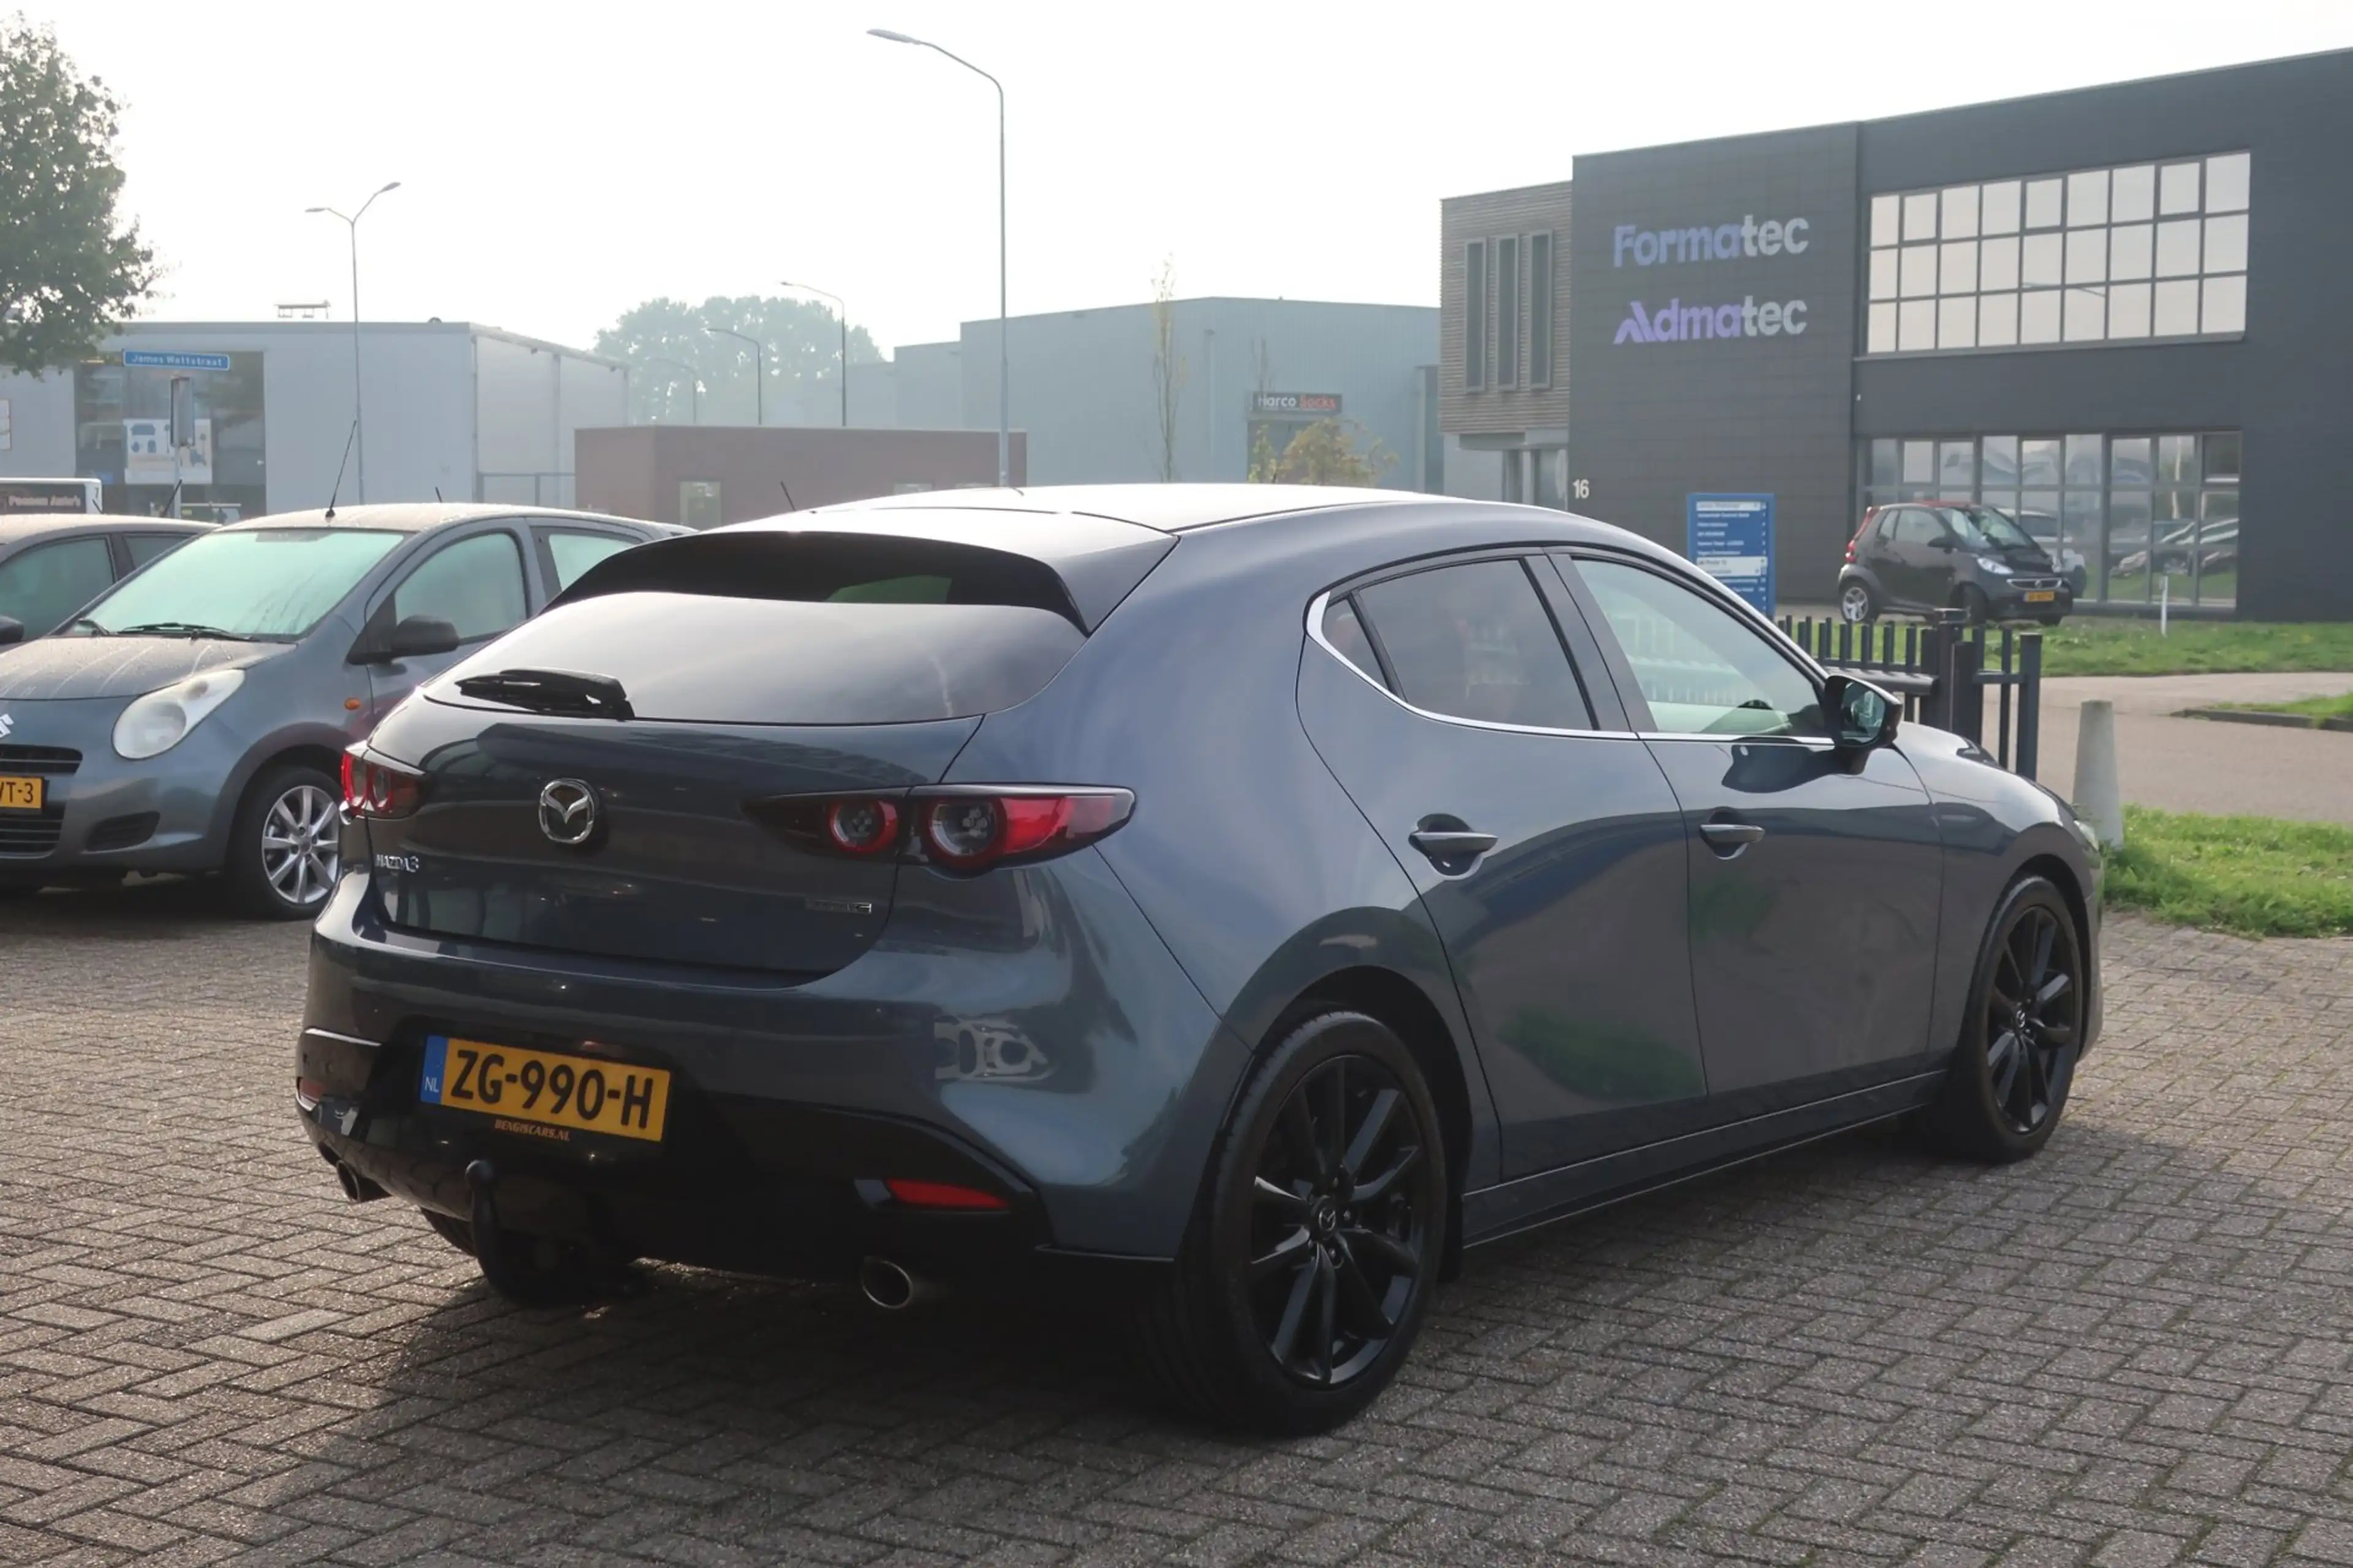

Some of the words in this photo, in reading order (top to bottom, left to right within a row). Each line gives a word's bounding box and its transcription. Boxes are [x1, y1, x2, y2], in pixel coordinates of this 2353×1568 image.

[1613, 214, 1809, 267] Formatec
[1613, 295, 1807, 344] Admatec
[131, 355, 164, 363] James
[1257, 393, 1297, 407] Harco
[1572, 479, 1590, 499] 16
[424, 1077, 439, 1093] NL
[450, 1050, 653, 1129] ZG-990-H
